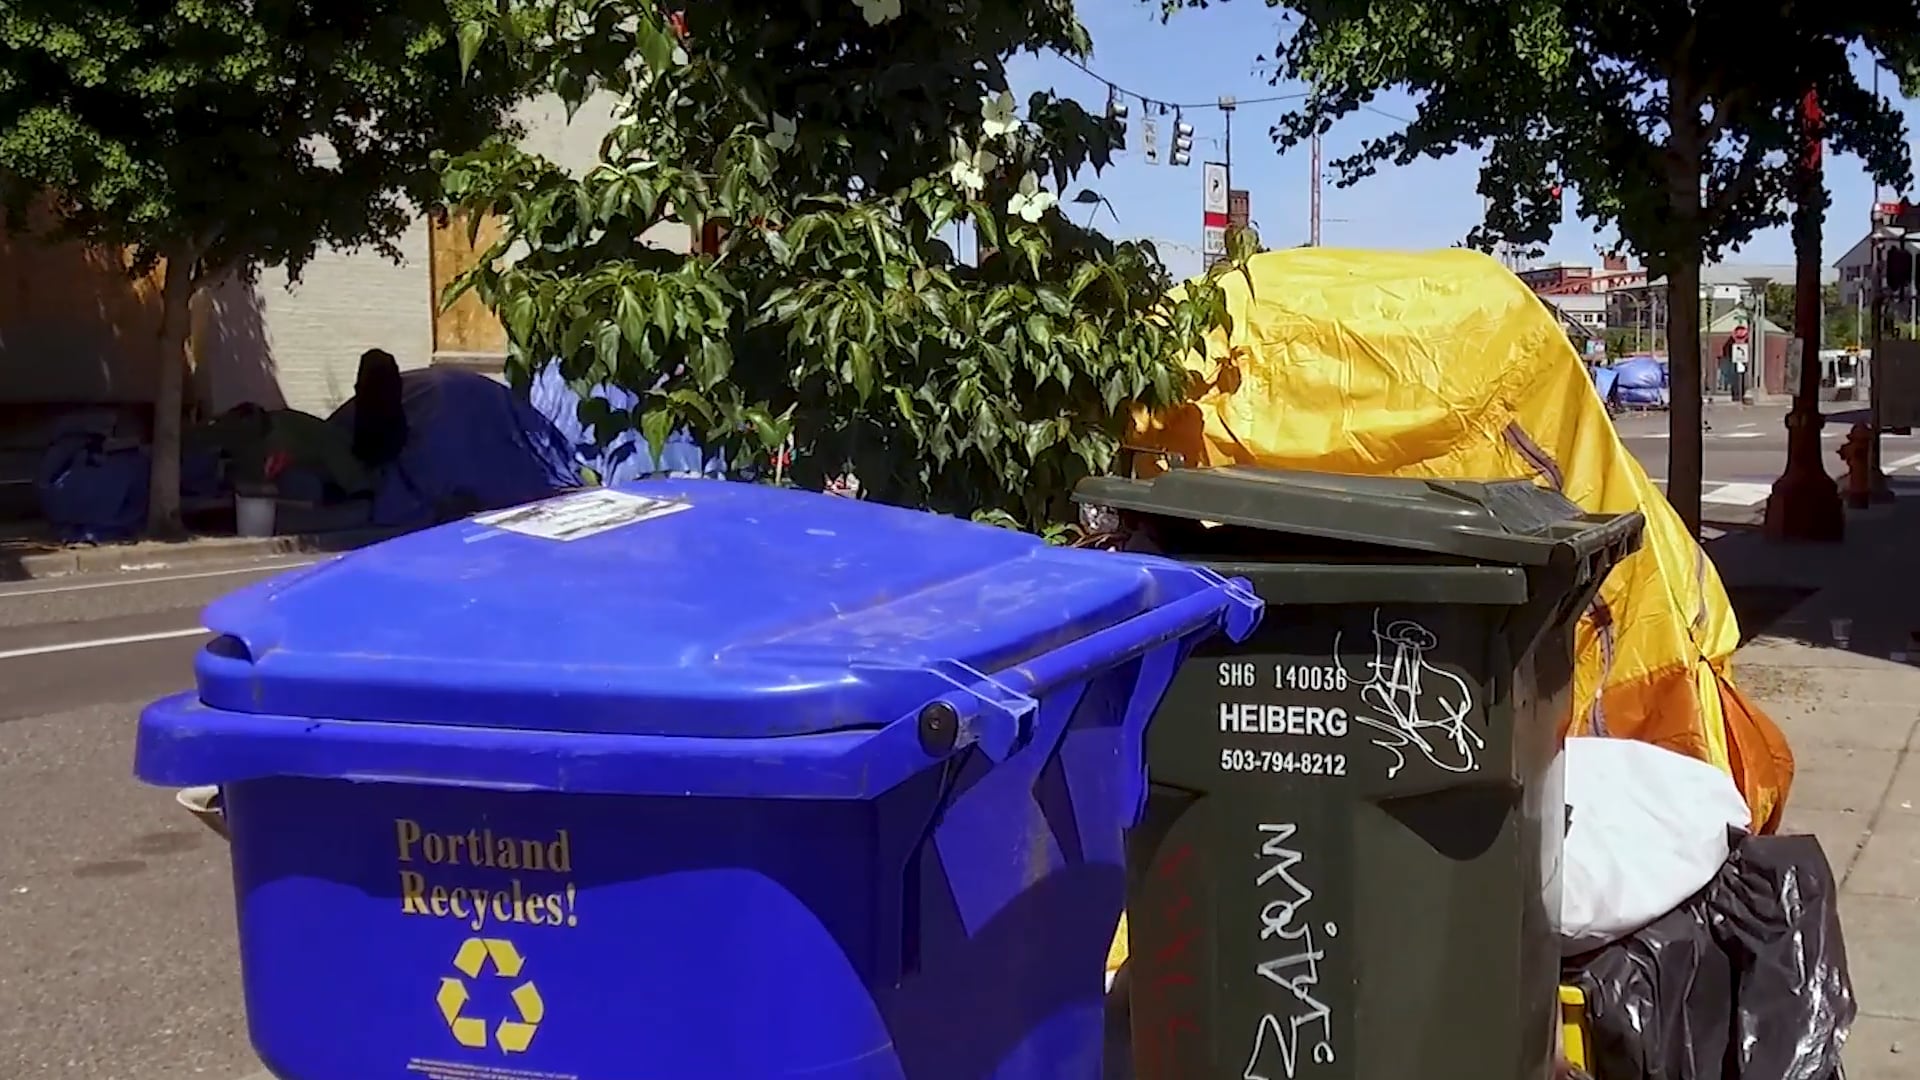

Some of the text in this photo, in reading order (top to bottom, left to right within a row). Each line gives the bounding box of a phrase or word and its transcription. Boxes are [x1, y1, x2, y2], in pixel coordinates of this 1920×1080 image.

[1274, 664, 1348, 692] 140036
[1218, 702, 1348, 737] HEIBERG
[1220, 748, 1347, 776] 503-794-8212
[395, 819, 572, 872] Portland
[402, 871, 577, 931] Recycles!
